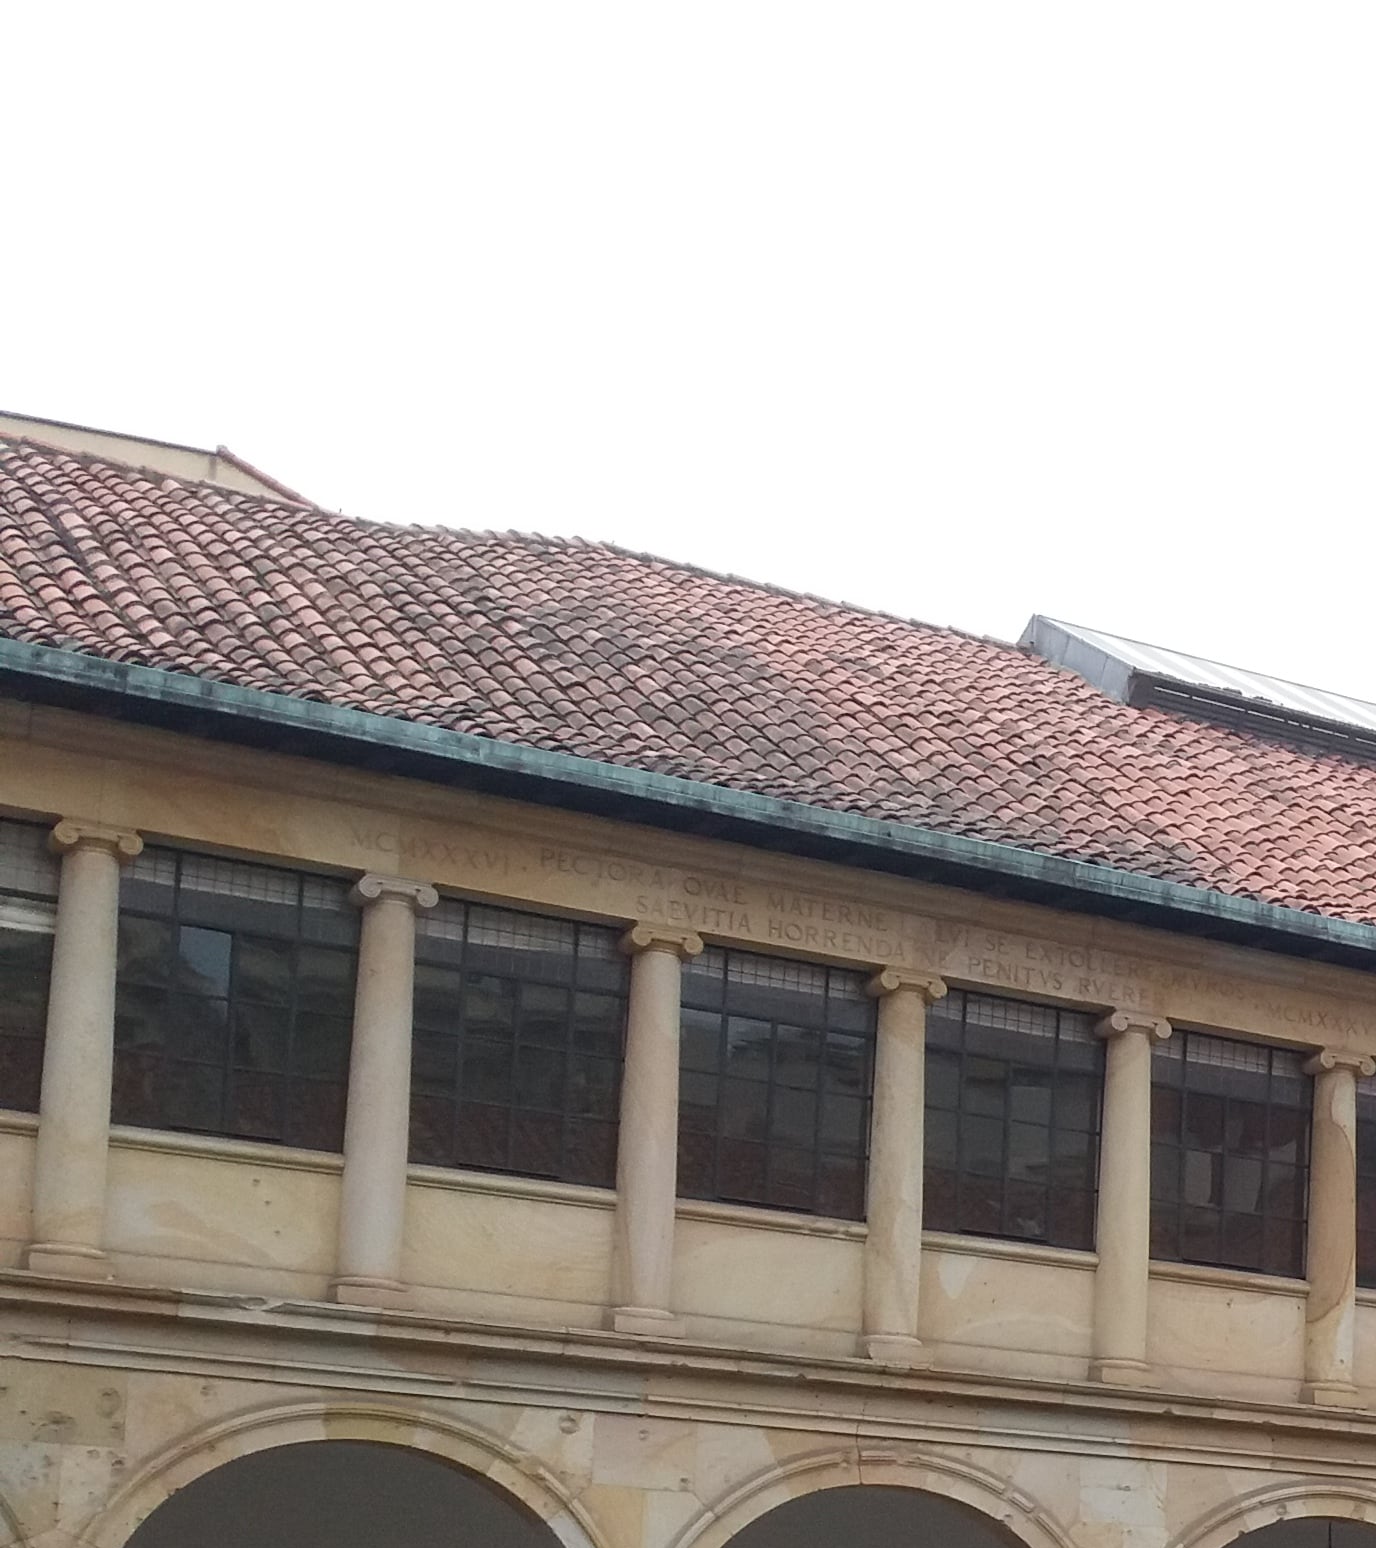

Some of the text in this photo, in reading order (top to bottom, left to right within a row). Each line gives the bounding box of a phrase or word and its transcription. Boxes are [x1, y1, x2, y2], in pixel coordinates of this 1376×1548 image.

[540, 847, 664, 890] PECTORA
[636, 894, 751, 933] SAEVITIA
[768, 918, 905, 961] HORRENDA
[967, 955, 1062, 991] PENITVS
